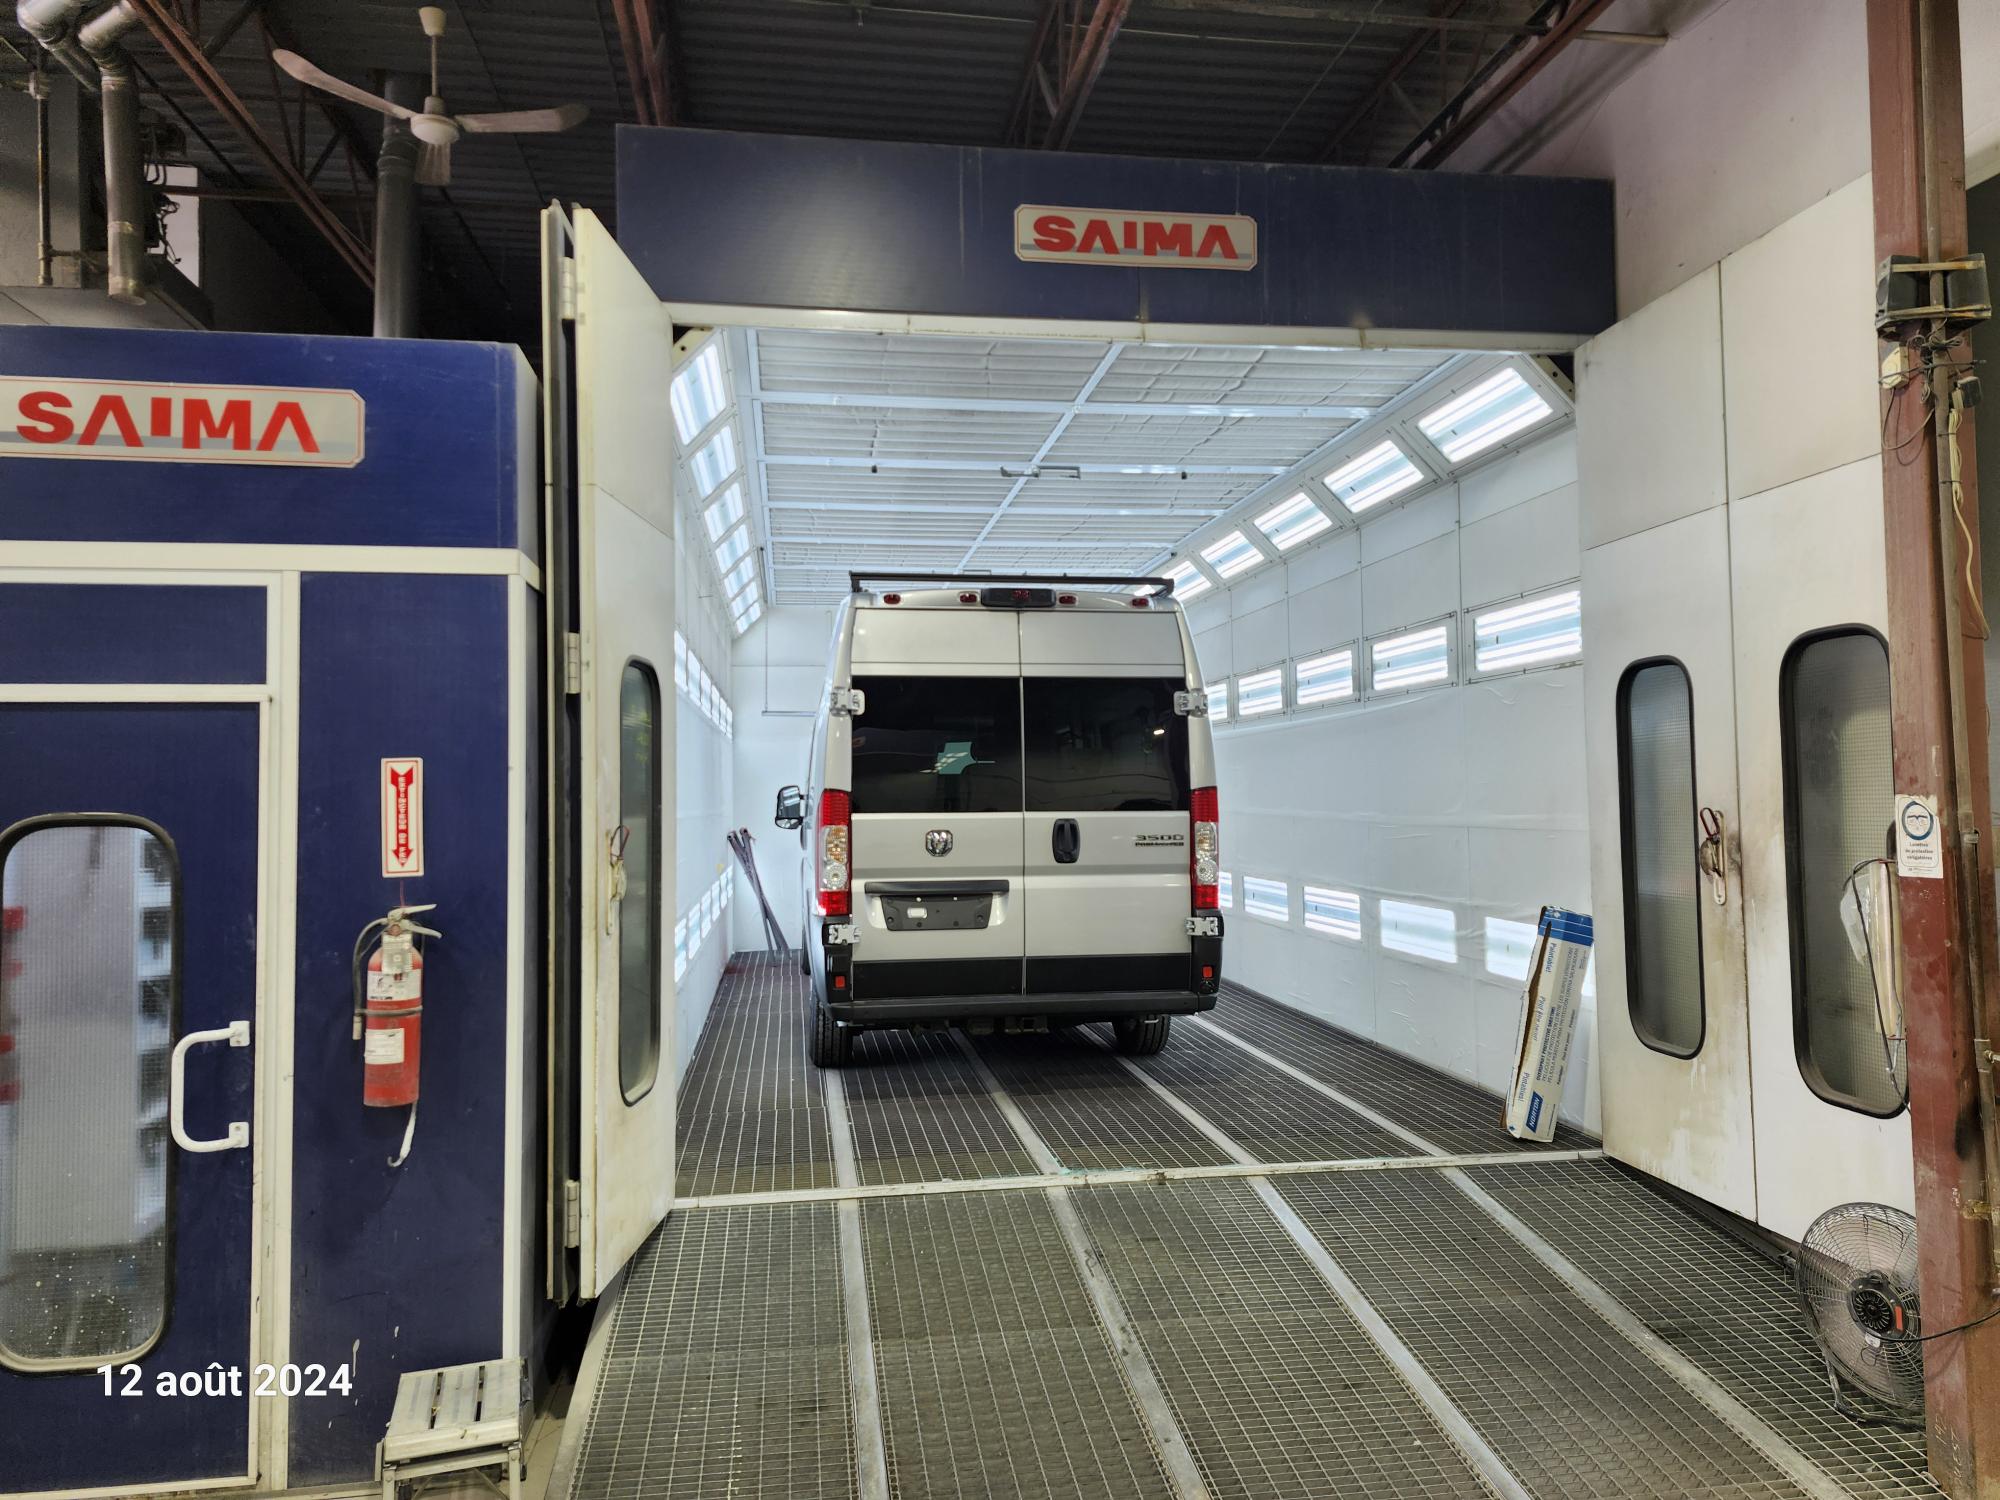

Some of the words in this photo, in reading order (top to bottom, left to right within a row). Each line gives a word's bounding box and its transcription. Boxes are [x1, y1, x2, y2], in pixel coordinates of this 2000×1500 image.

[1033, 215, 1238, 259] SAIMA
[17, 391, 320, 453] SAIMA
[1527, 1096, 1540, 1128] NORTON
